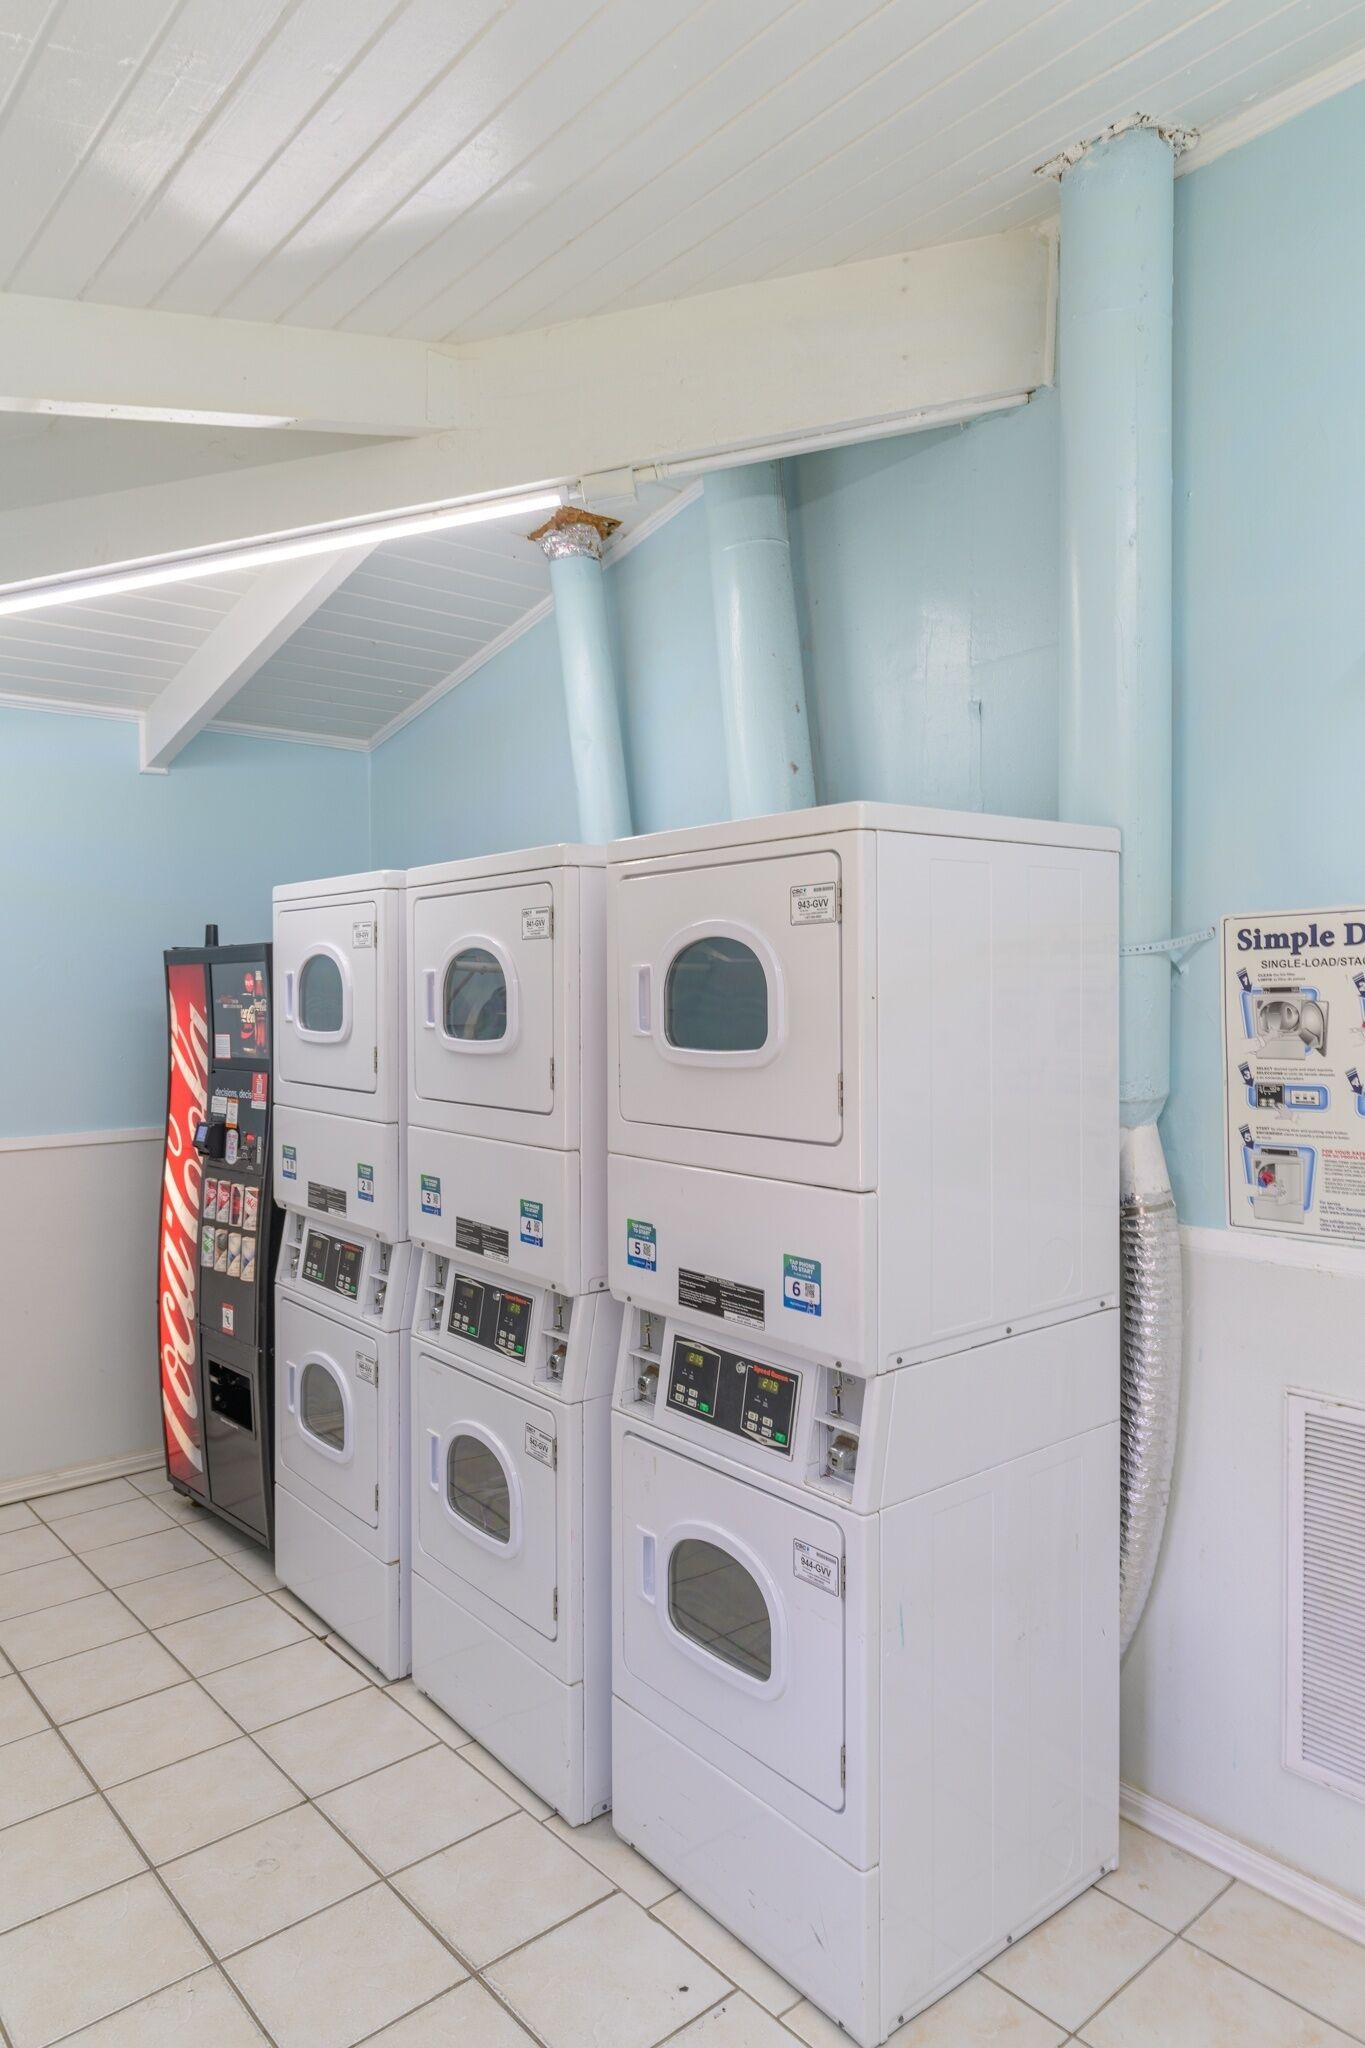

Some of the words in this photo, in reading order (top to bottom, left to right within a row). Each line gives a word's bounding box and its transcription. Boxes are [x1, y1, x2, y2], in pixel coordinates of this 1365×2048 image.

[798, 898, 828, 910] 943-GVV
[1237, 924, 1335, 955] Simple
[361, 1180, 366, 1191] 2
[426, 1193, 431, 1204] 3
[526, 1220, 531, 1233] 4
[634, 1242, 640, 1255] 5
[790, 1258, 798, 1267] TAP
[799, 1260, 815, 1270] PHONE
[798, 1266, 813, 1274] START
[792, 1281, 801, 1297] 6
[801, 1556, 832, 1577] 944-GVV
